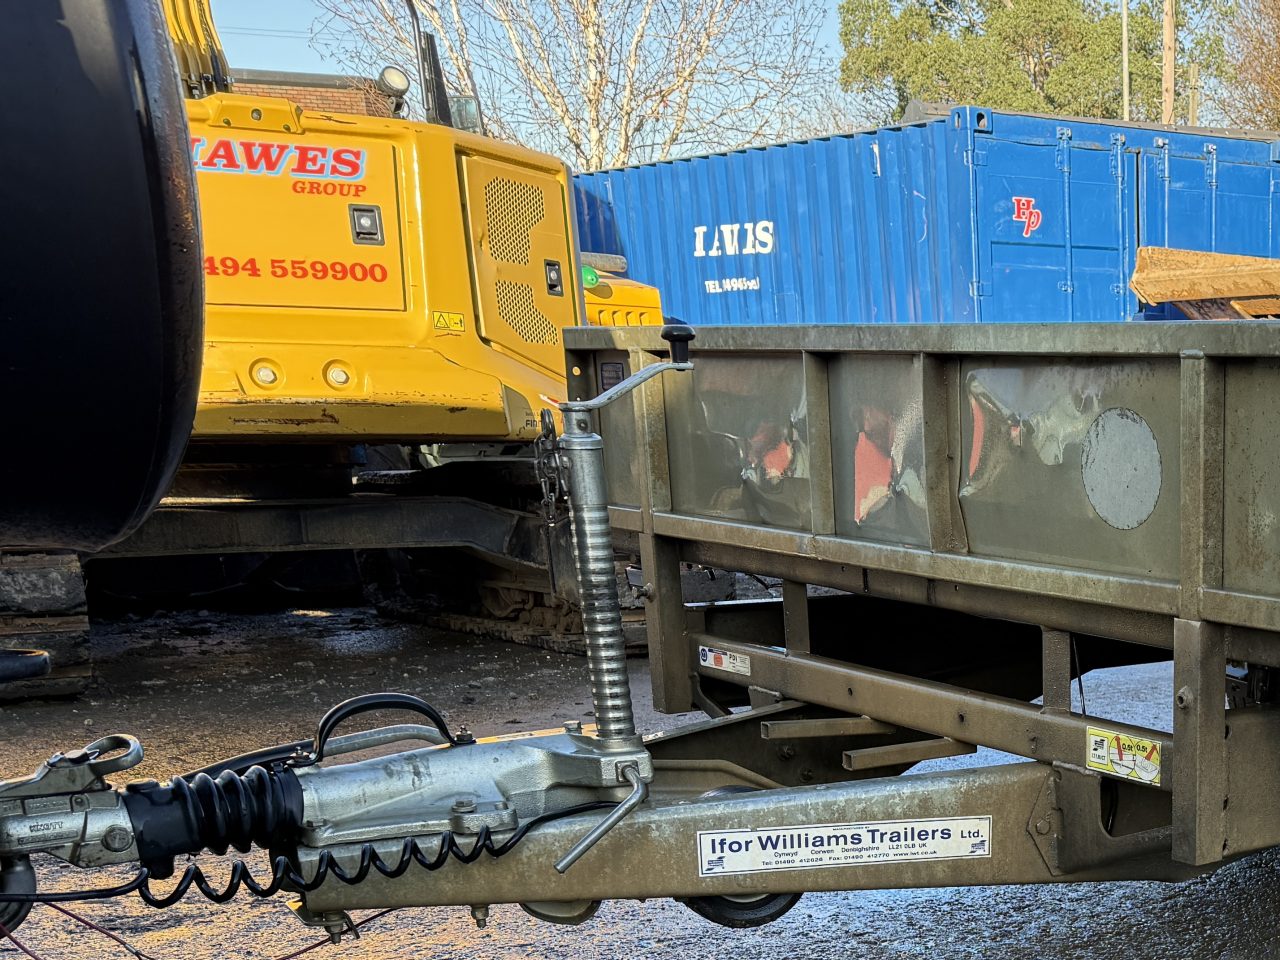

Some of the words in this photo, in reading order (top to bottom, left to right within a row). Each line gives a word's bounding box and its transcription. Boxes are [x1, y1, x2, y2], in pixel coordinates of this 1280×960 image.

[291, 180, 367, 198] GROUP
[270, 258, 388, 283] 559900
[1136, 745, 1148, 753] 0.5t
[711, 837, 753, 854] Ifor
[757, 832, 863, 851] Williams
[867, 826, 952, 844] Trailers
[960, 828, 984, 839] Ltd.
